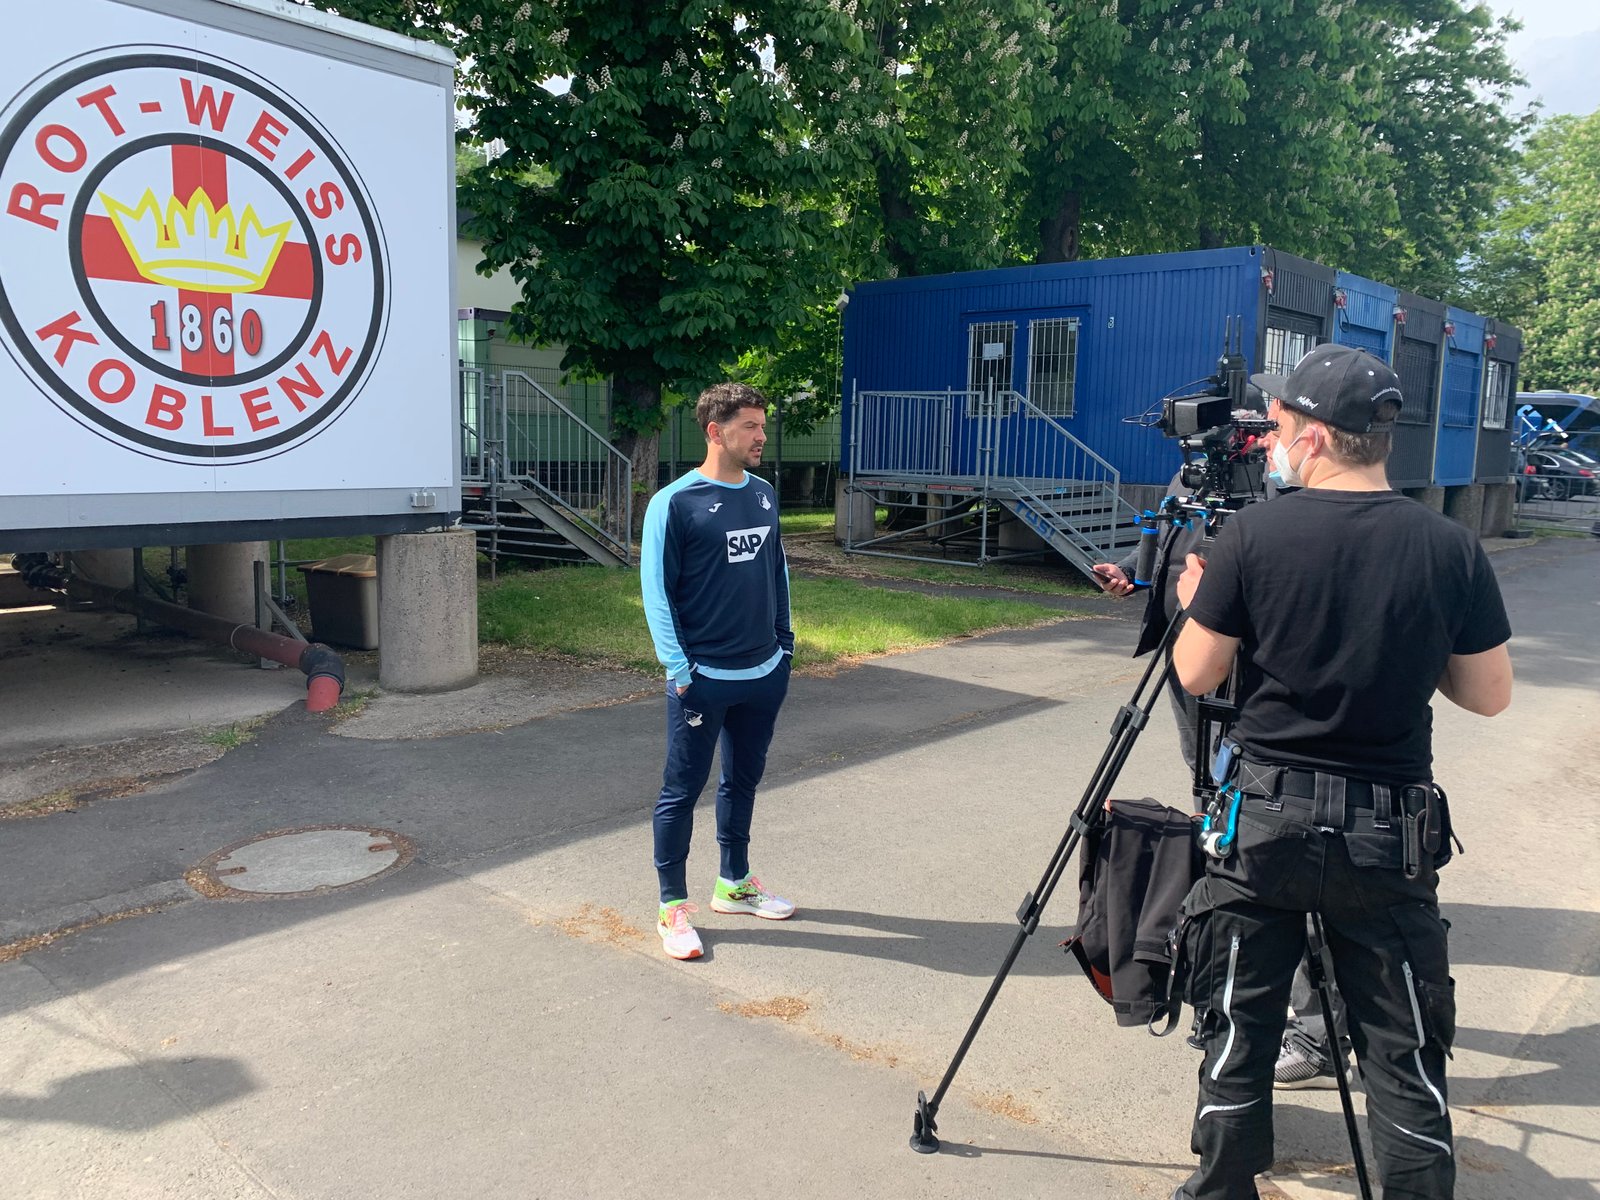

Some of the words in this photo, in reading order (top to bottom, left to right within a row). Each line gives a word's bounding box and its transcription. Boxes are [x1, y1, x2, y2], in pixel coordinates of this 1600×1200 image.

[7, 77, 362, 266] ROT-WEISS
[151, 300, 263, 356] 1860
[36, 311, 352, 437] KOBLENZ
[728, 534, 762, 557] SAP
